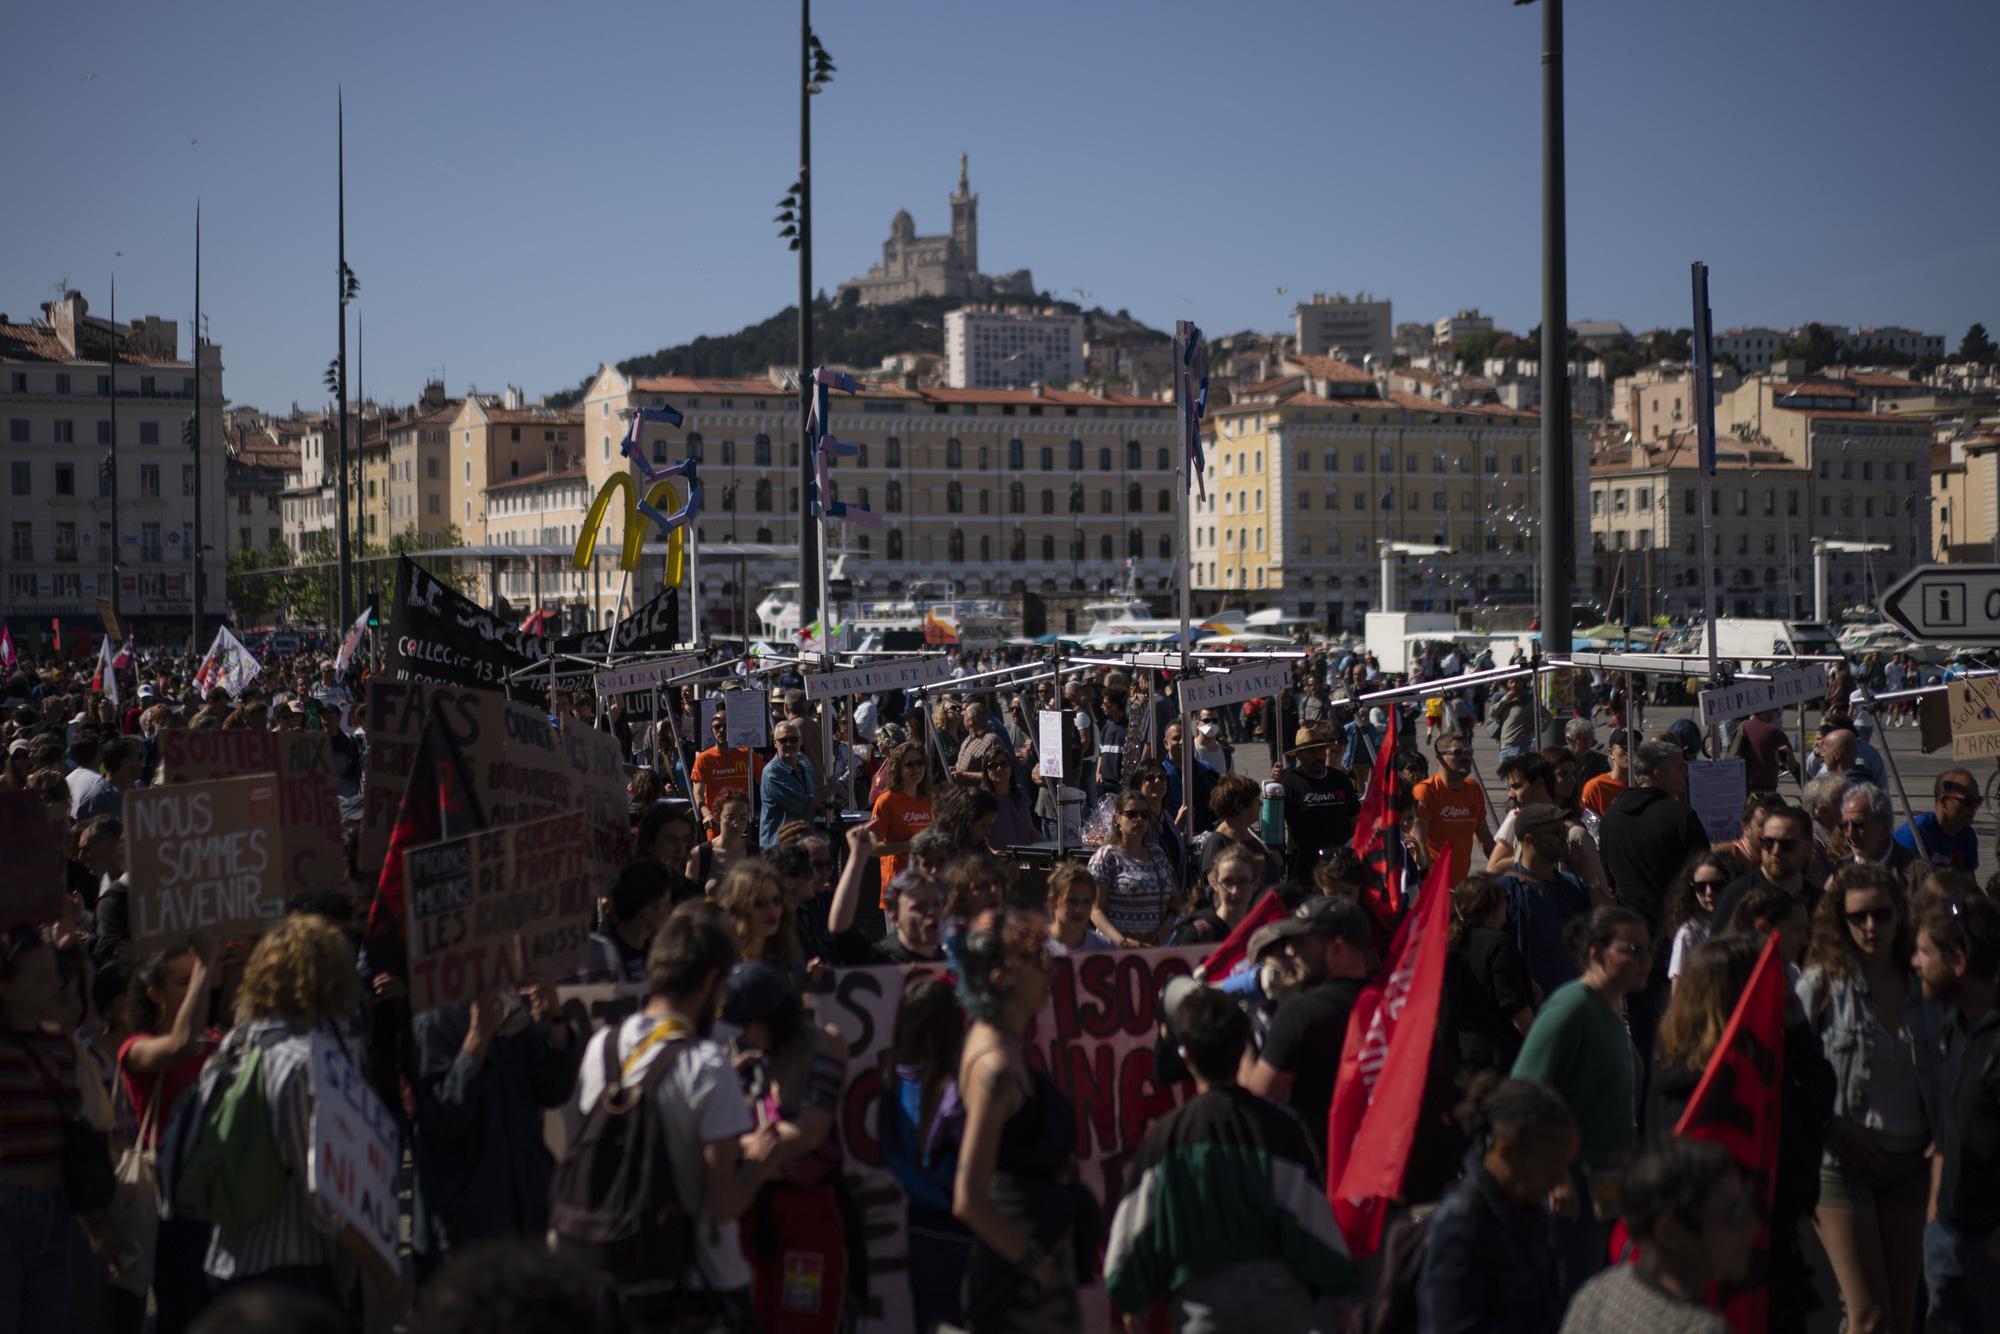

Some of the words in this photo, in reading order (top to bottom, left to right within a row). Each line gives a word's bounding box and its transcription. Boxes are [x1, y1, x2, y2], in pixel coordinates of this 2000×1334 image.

[472, 660, 493, 682] 13
[810, 671, 892, 693] ENTRAIDE
[901, 668, 919, 681] ET
[926, 665, 944, 679] LA
[1708, 687, 1761, 716] PEUPLE
[1767, 680, 1803, 701] POUR
[1807, 672, 1825, 691] LA
[165, 730, 279, 769] SOUTIEN
[135, 791, 214, 841] NOUS
[158, 829, 269, 887] SOMMES
[413, 846, 468, 881] MOINS
[415, 877, 472, 916] MOINS
[423, 911, 466, 956] LES
